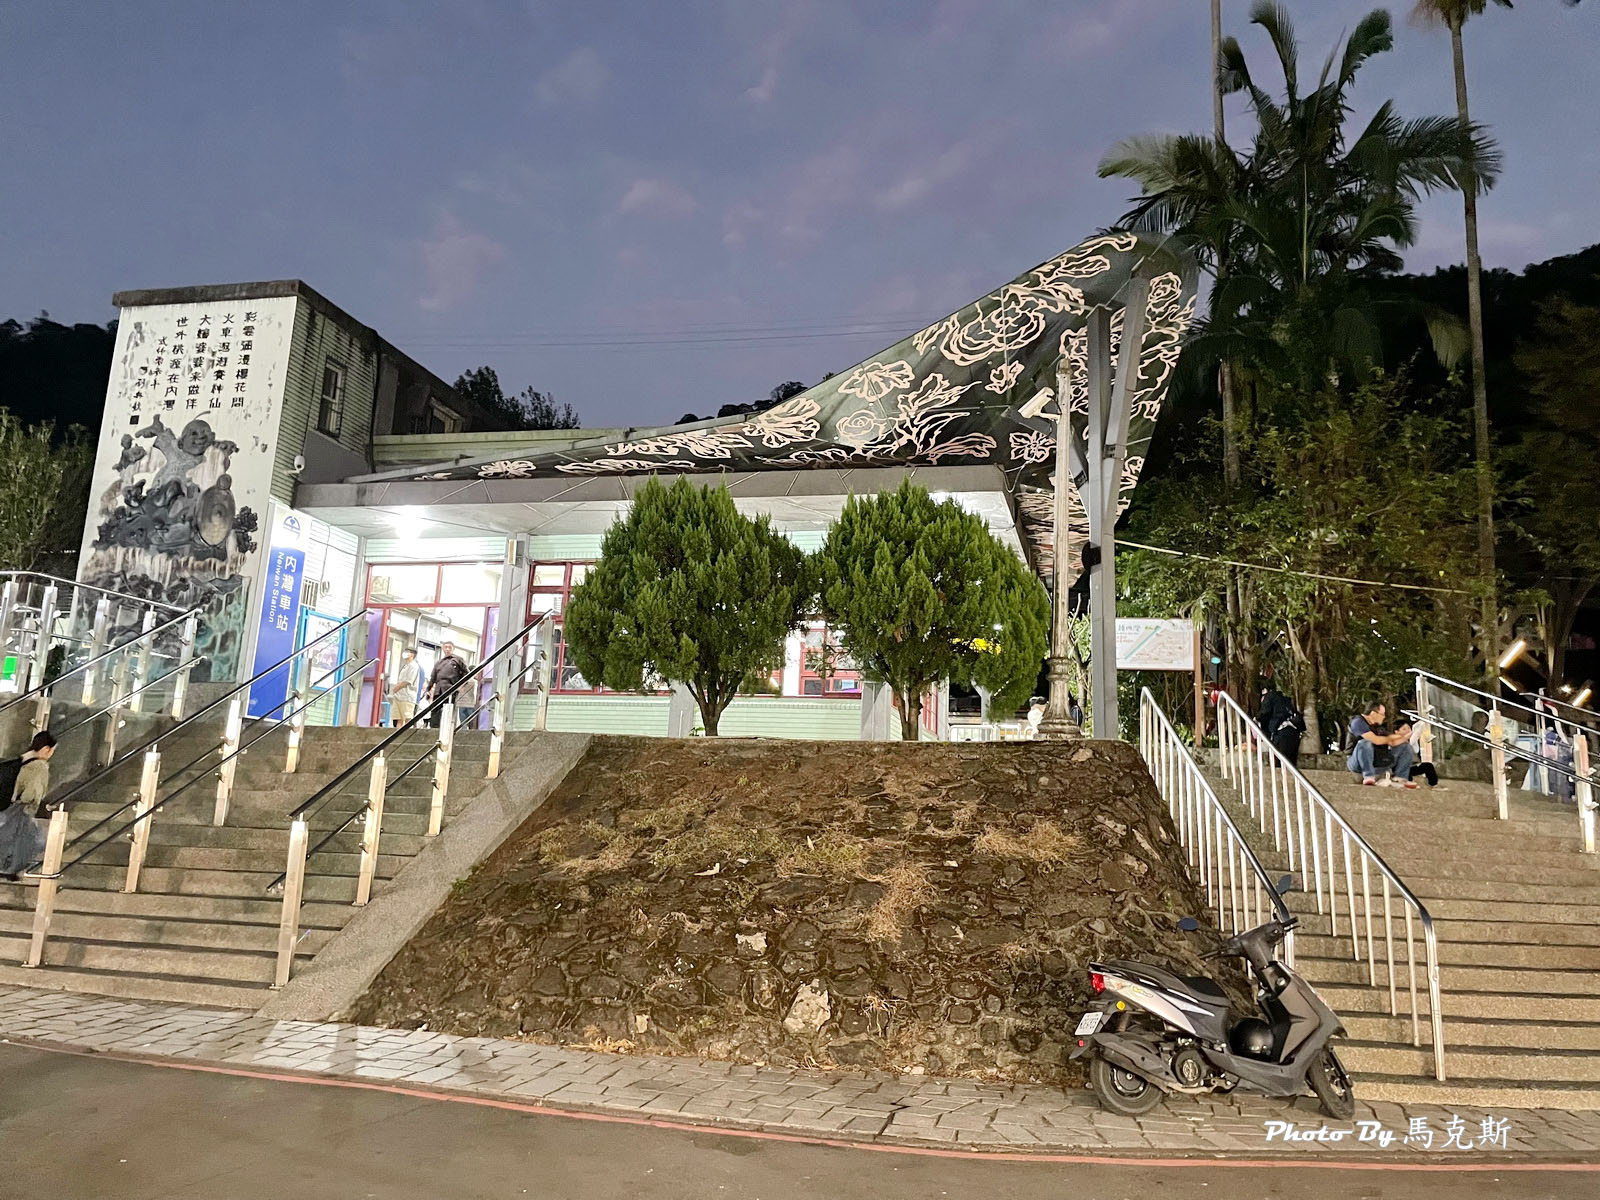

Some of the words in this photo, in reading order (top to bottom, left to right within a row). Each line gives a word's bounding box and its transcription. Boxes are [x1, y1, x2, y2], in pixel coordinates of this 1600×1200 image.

[274, 552, 285, 587] Neiwan
[268, 588, 280, 623] Station
[276, 556, 297, 632] 內灣車站
